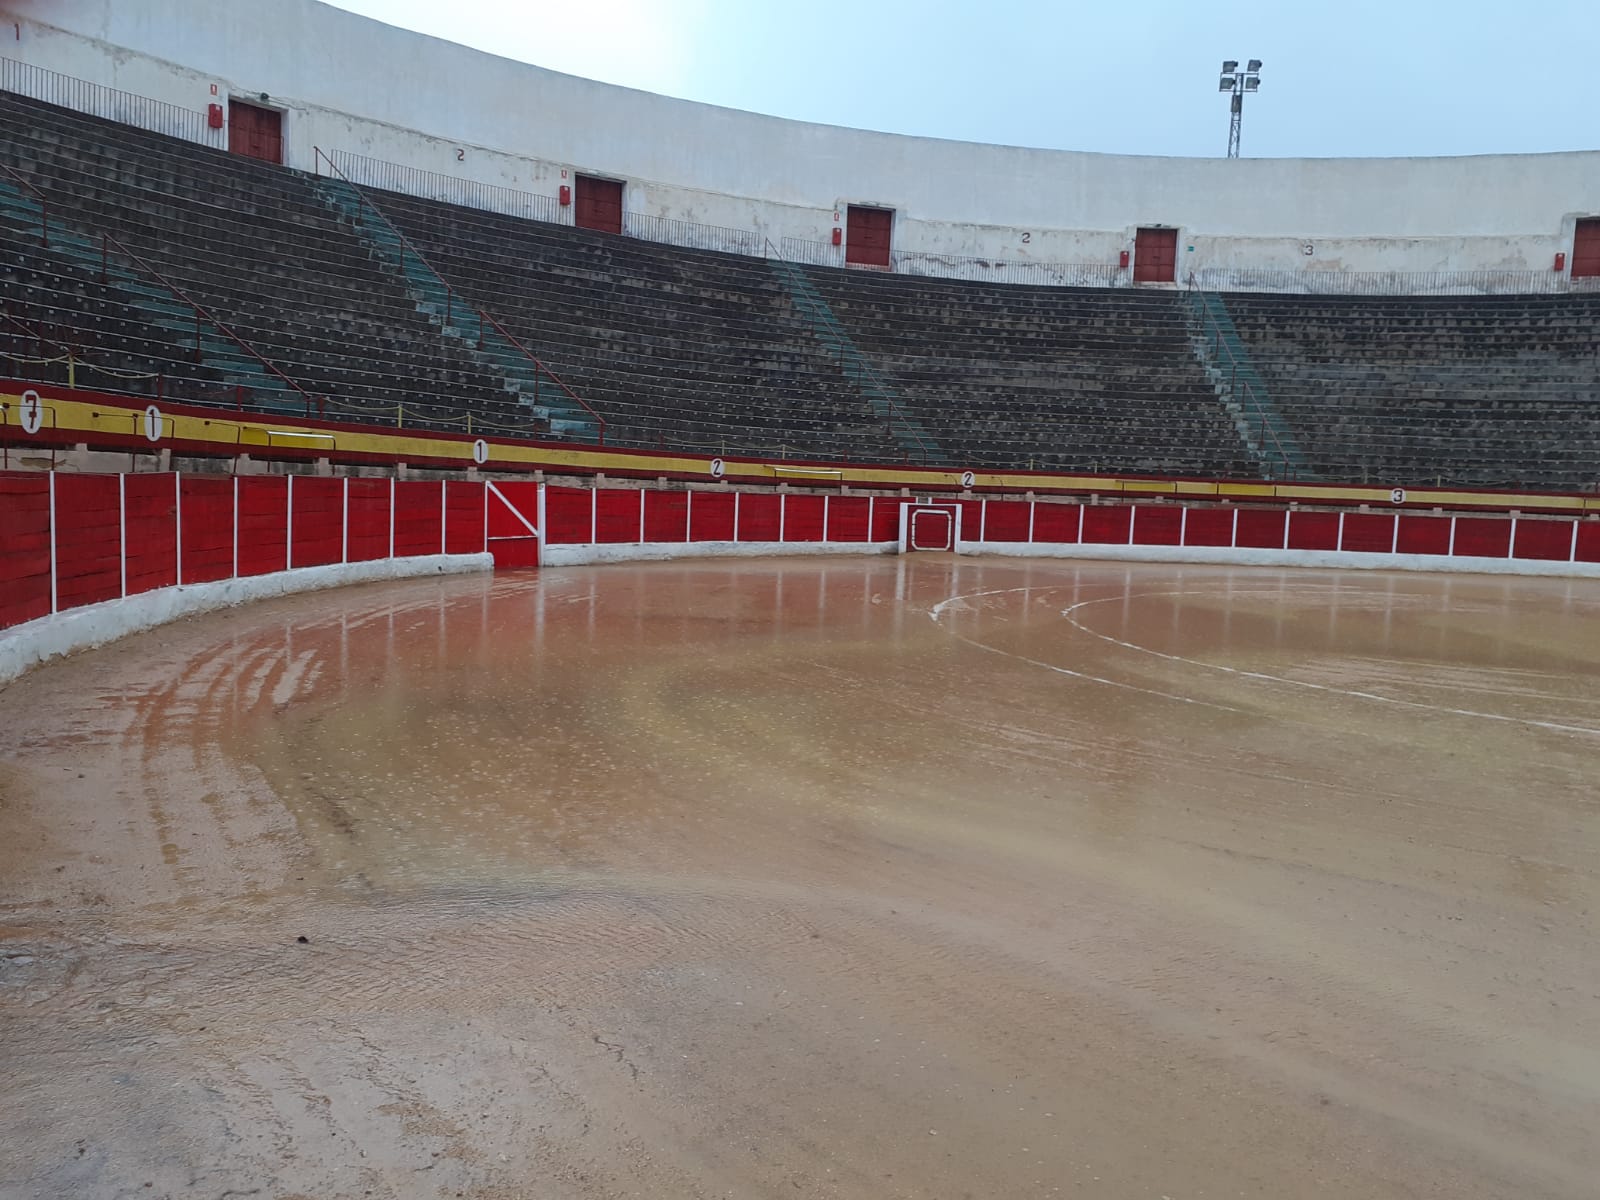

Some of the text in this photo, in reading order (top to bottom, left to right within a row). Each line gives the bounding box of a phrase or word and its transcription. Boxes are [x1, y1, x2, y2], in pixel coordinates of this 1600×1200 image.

[13, 23, 20, 41] 1
[457, 148, 465, 161] 2
[1022, 232, 1031, 244] 2
[1305, 245, 1313, 255] 3
[26, 394, 37, 429] 7
[713, 460, 721, 475] 2
[964, 473, 972, 486] 2
[1393, 490, 1402, 502] 3
